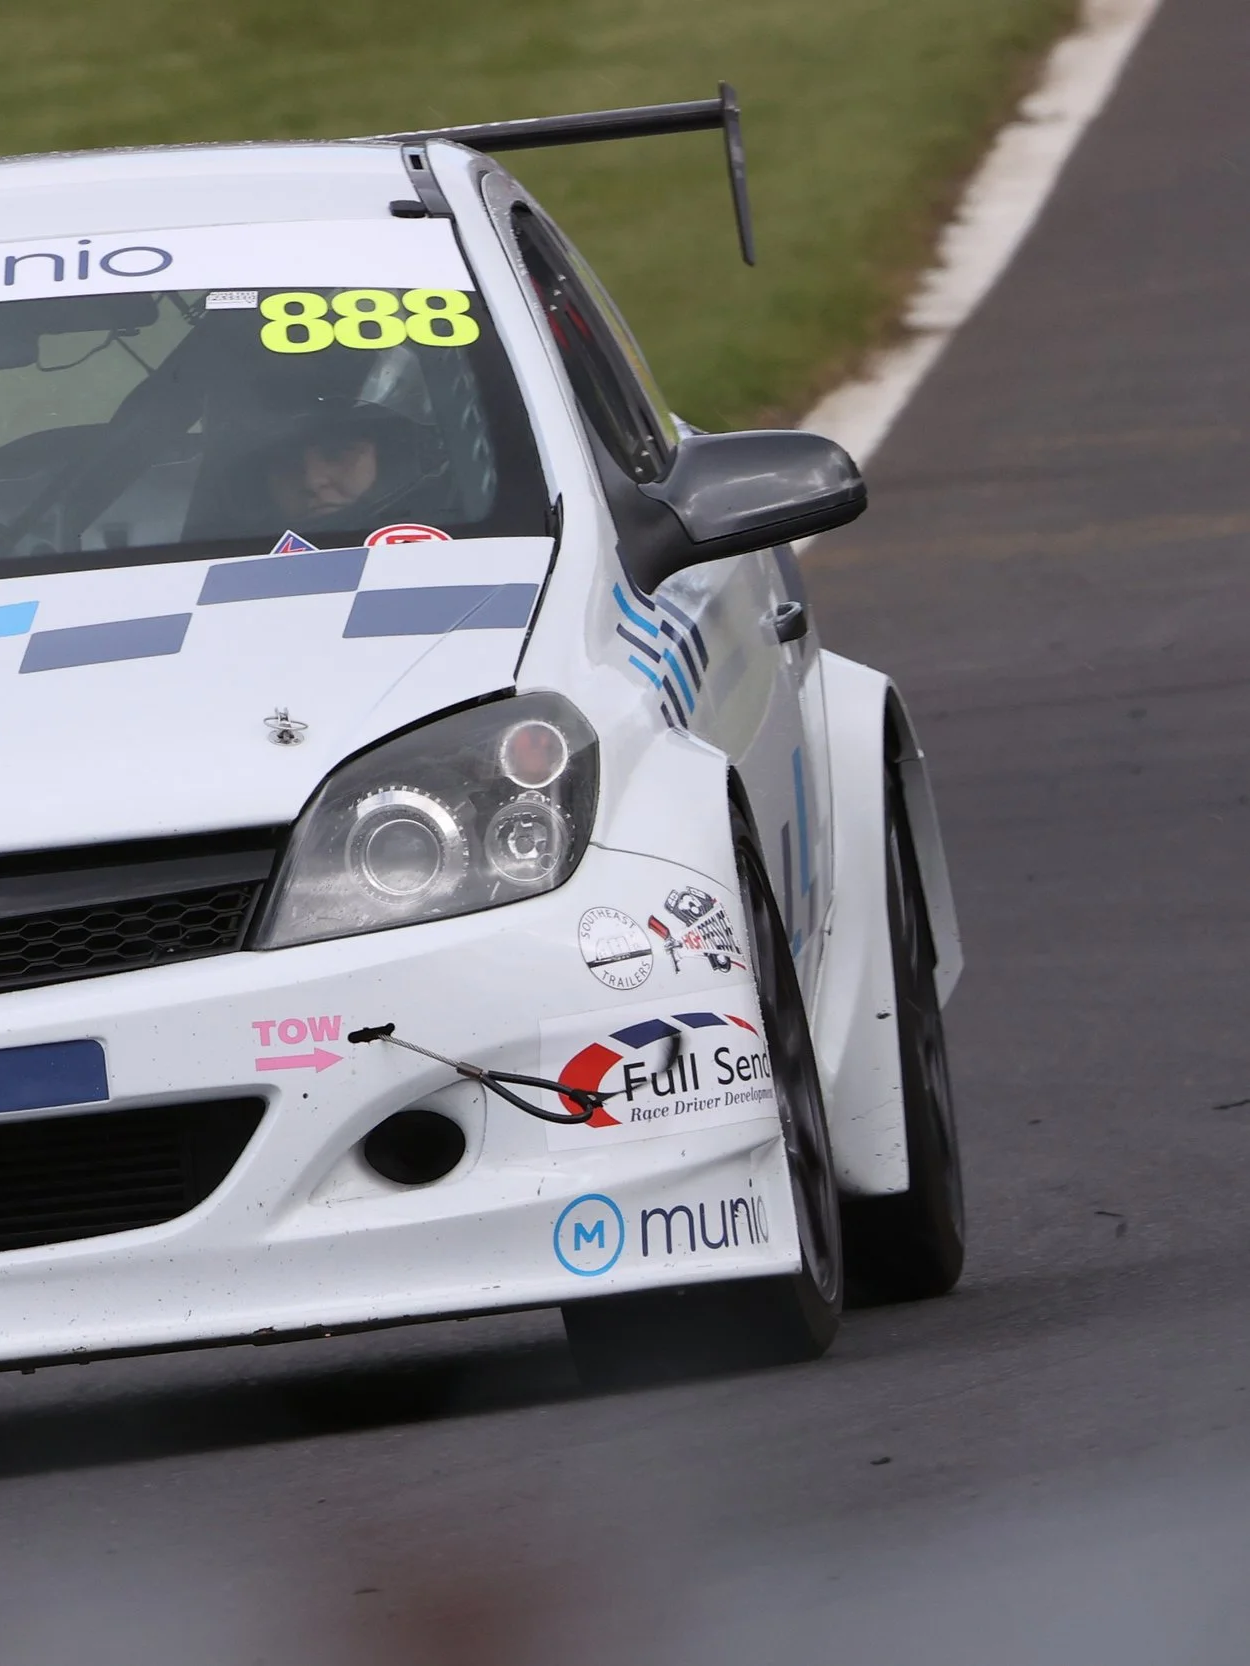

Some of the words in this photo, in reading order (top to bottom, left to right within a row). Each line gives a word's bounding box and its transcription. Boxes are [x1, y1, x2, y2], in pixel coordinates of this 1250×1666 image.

[260, 288, 480, 353] 888
[581, 909, 636, 939] SOUTHEAST
[602, 960, 650, 987] TRAILERS
[252, 1015, 342, 1046] TOW
[623, 1053, 699, 1101] Full
[714, 1042, 771, 1085] Send
[630, 1106, 669, 1122] Race
[674, 1097, 720, 1115] Driver
[574, 1220, 605, 1251] M
[641, 1178, 769, 1257] munio
